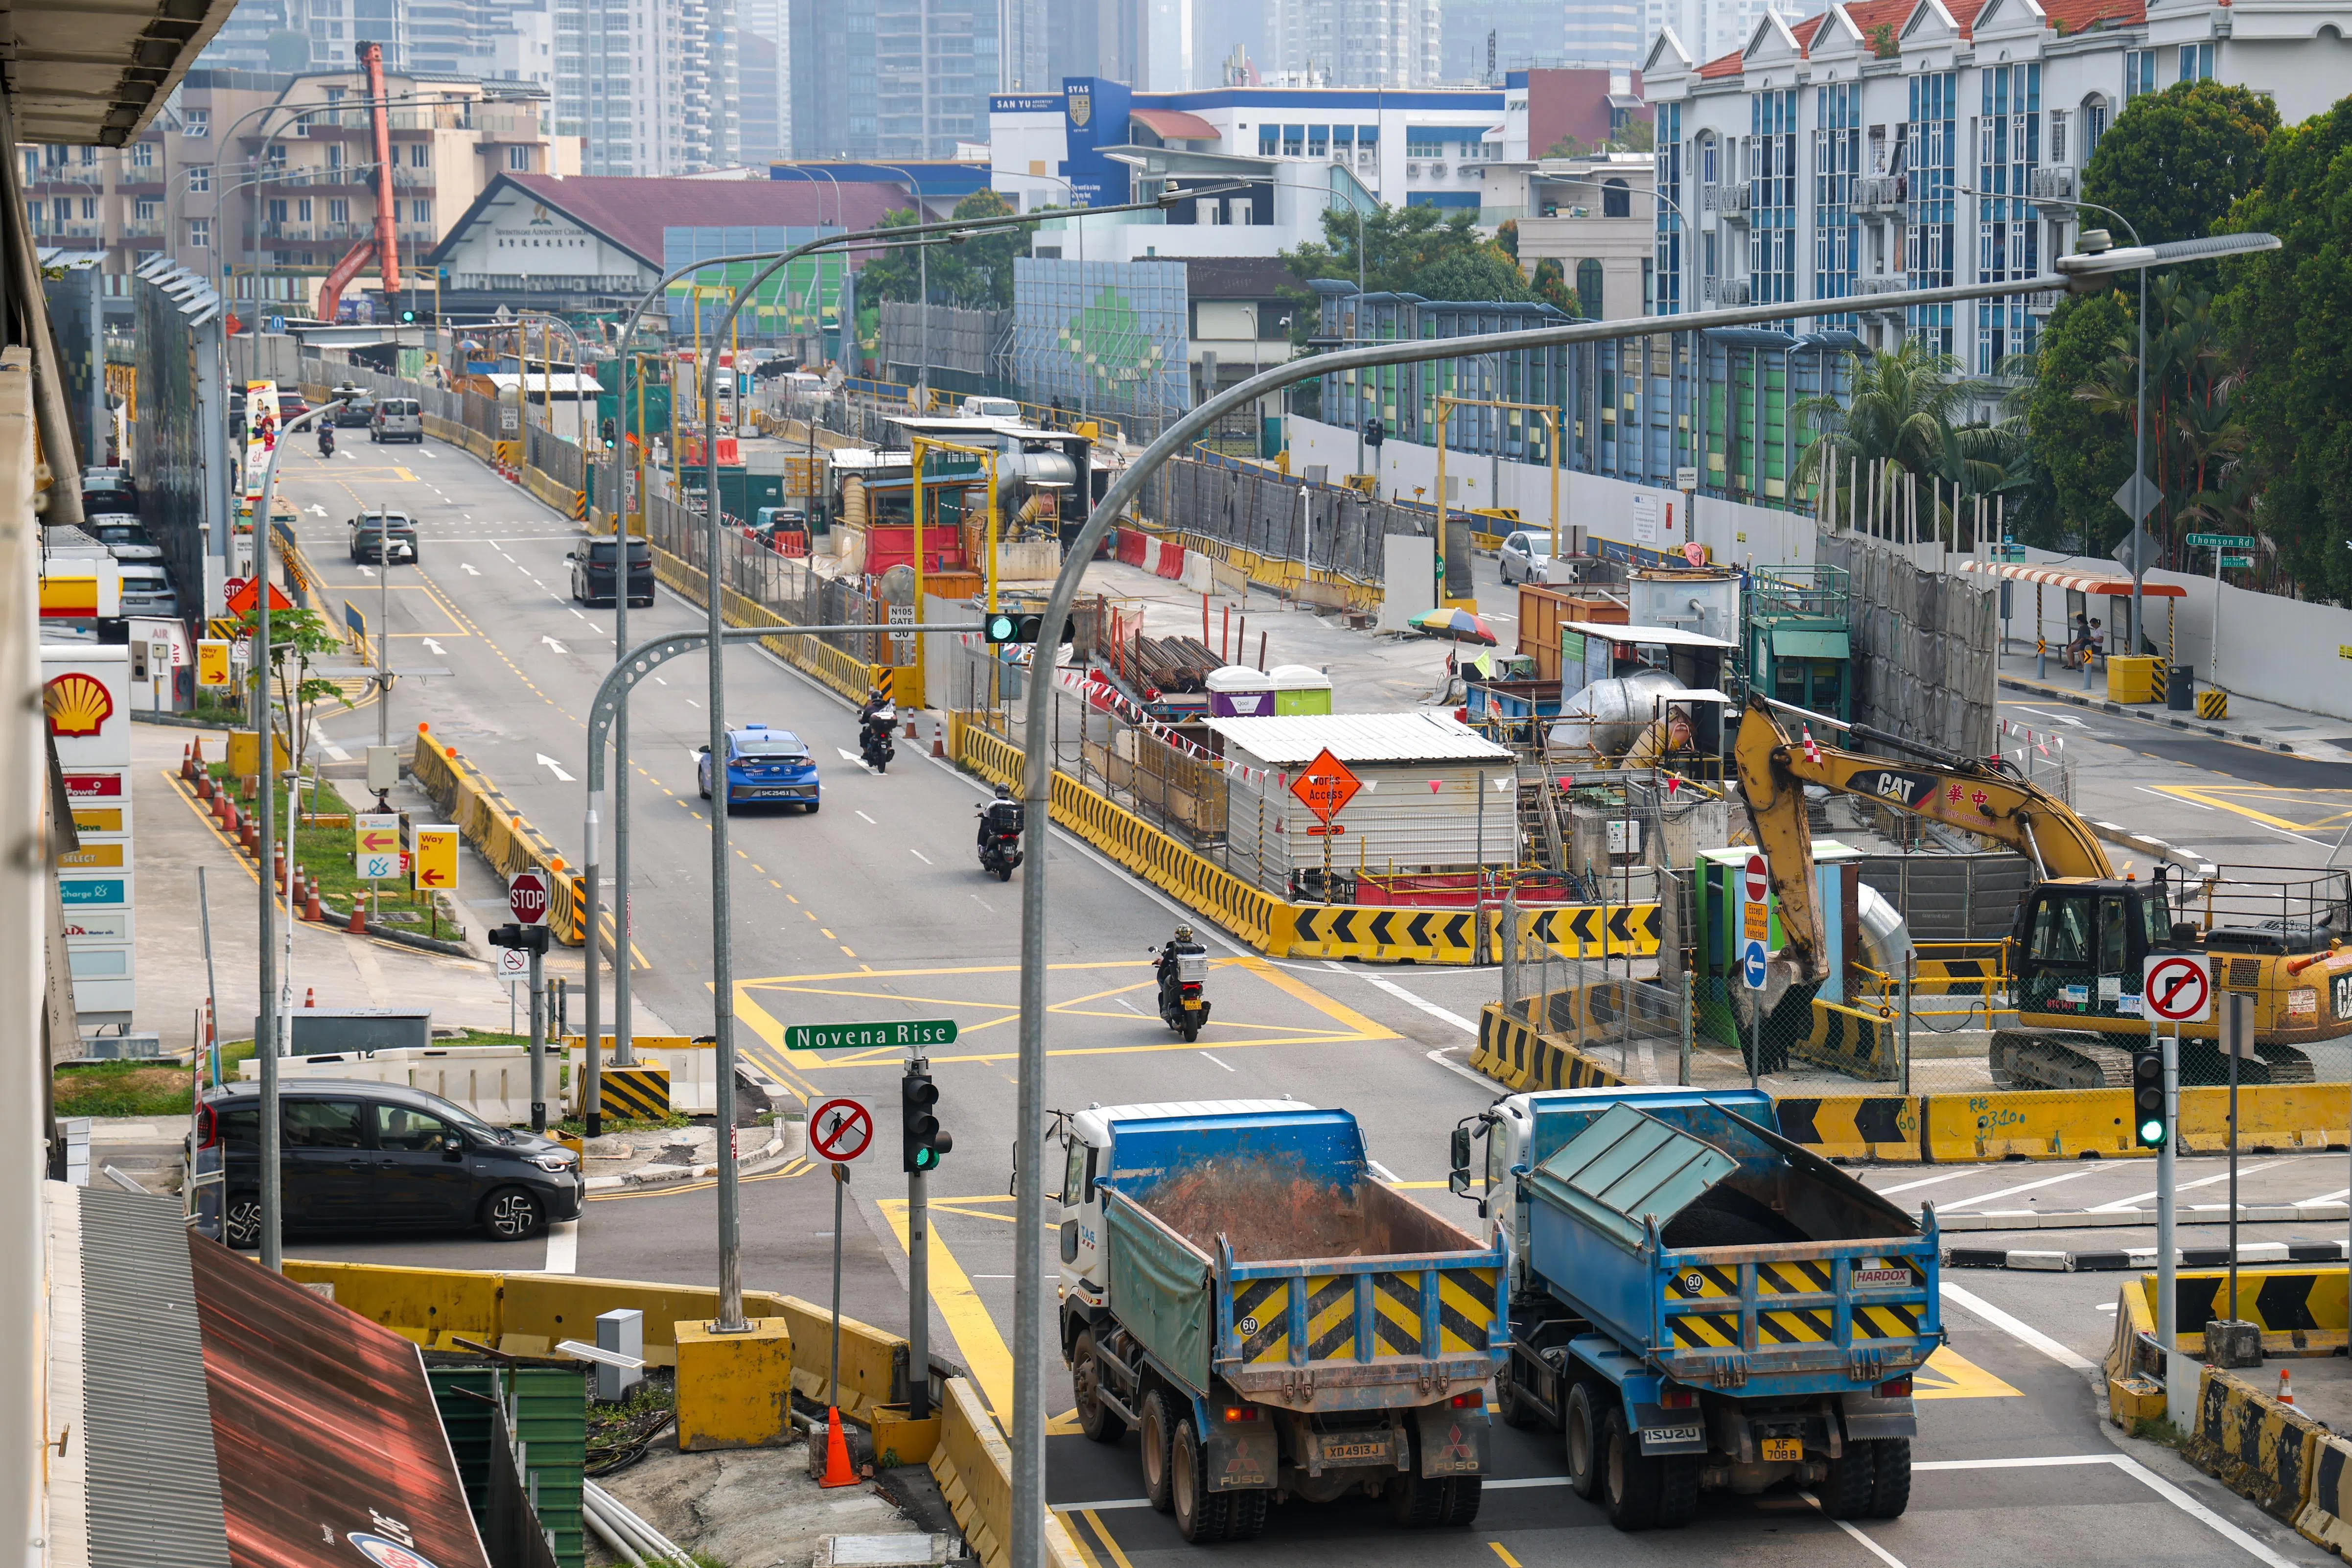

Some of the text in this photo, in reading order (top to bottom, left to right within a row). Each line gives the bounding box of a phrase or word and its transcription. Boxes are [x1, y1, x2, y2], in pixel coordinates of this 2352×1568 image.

[2192, 535, 2250, 546] Thomson Rd
[225, 585, 243, 597] STO
[152, 629, 168, 639] AIR
[1877, 772, 1915, 804] CAT
[1309, 789, 1343, 800] Access
[1961, 813, 1996, 829] CONTRACTOR
[421, 834, 444, 844] Way
[63, 855, 96, 863] SELECT
[61, 890, 92, 899] charge
[511, 889, 545, 910] STOP
[1748, 905, 1763, 916] Except
[1744, 916, 1767, 928] Authorised
[65, 927, 86, 935] LIX
[1747, 927, 1764, 938] Vehicles
[797, 1024, 946, 1047] Novena Rise
[1688, 1276, 1700, 1287] 60
[1857, 1270, 1908, 1282] HARDOX
[1242, 1319, 1256, 1330] 60
[1648, 1429, 1697, 1441] ISUZU
[1775, 1440, 1788, 1449] XF
[1329, 1445, 1379, 1457] XD4913J
[1767, 1450, 1797, 1460] 708B
[1435, 1461, 1479, 1472] FUSO
[1220, 1474, 1265, 1486] FUSO
